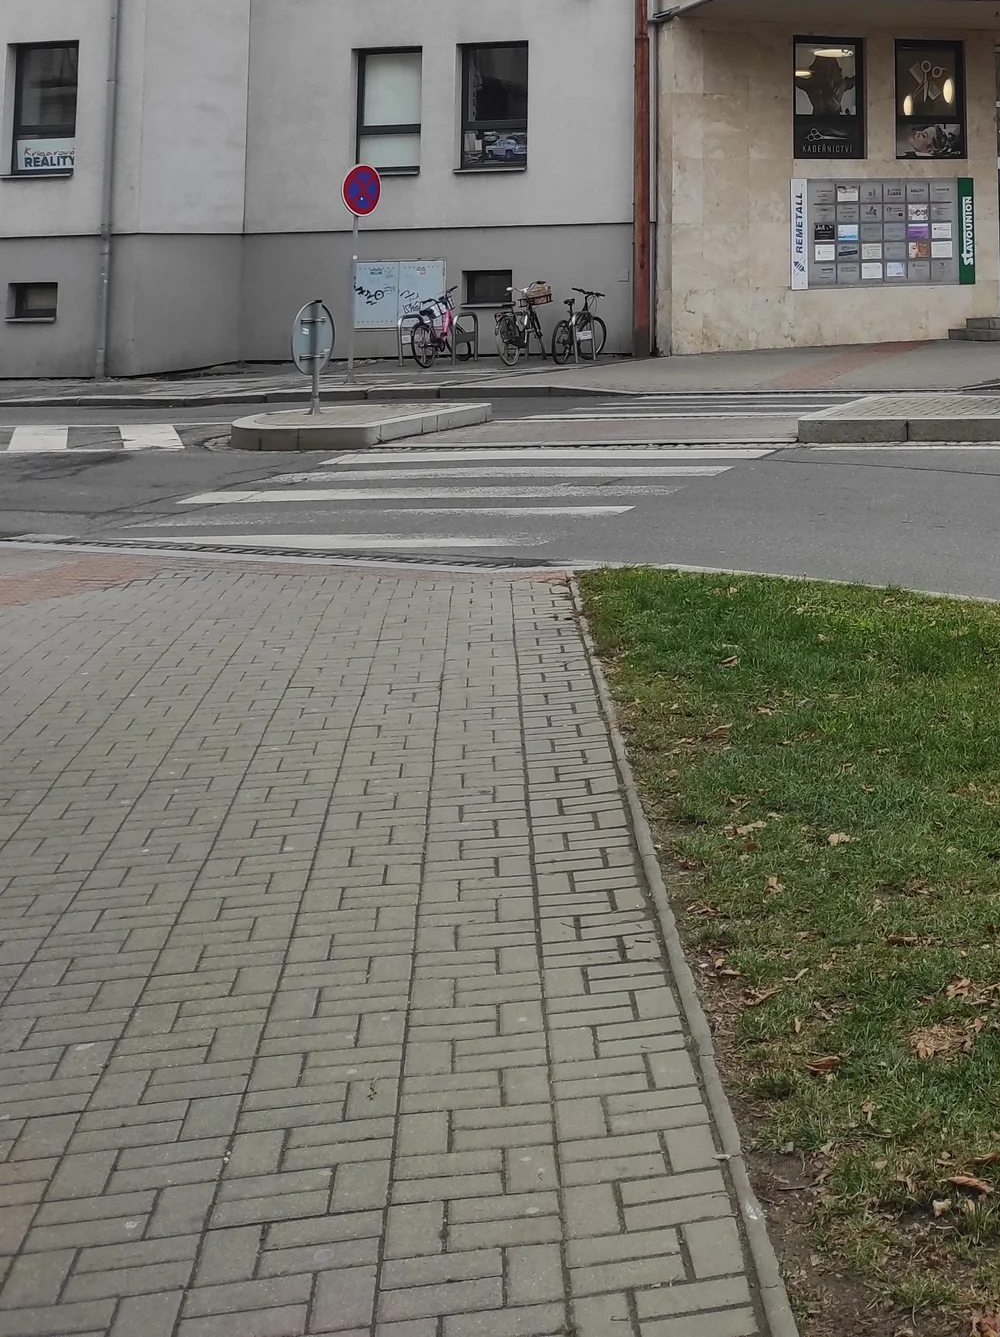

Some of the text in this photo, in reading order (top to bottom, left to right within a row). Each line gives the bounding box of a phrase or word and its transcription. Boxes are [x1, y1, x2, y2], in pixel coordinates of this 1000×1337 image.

[802, 143, 853, 153] KADEŘNICTVÍ
[24, 155, 75, 167] REALITY
[795, 192, 803, 254] REMETALL
